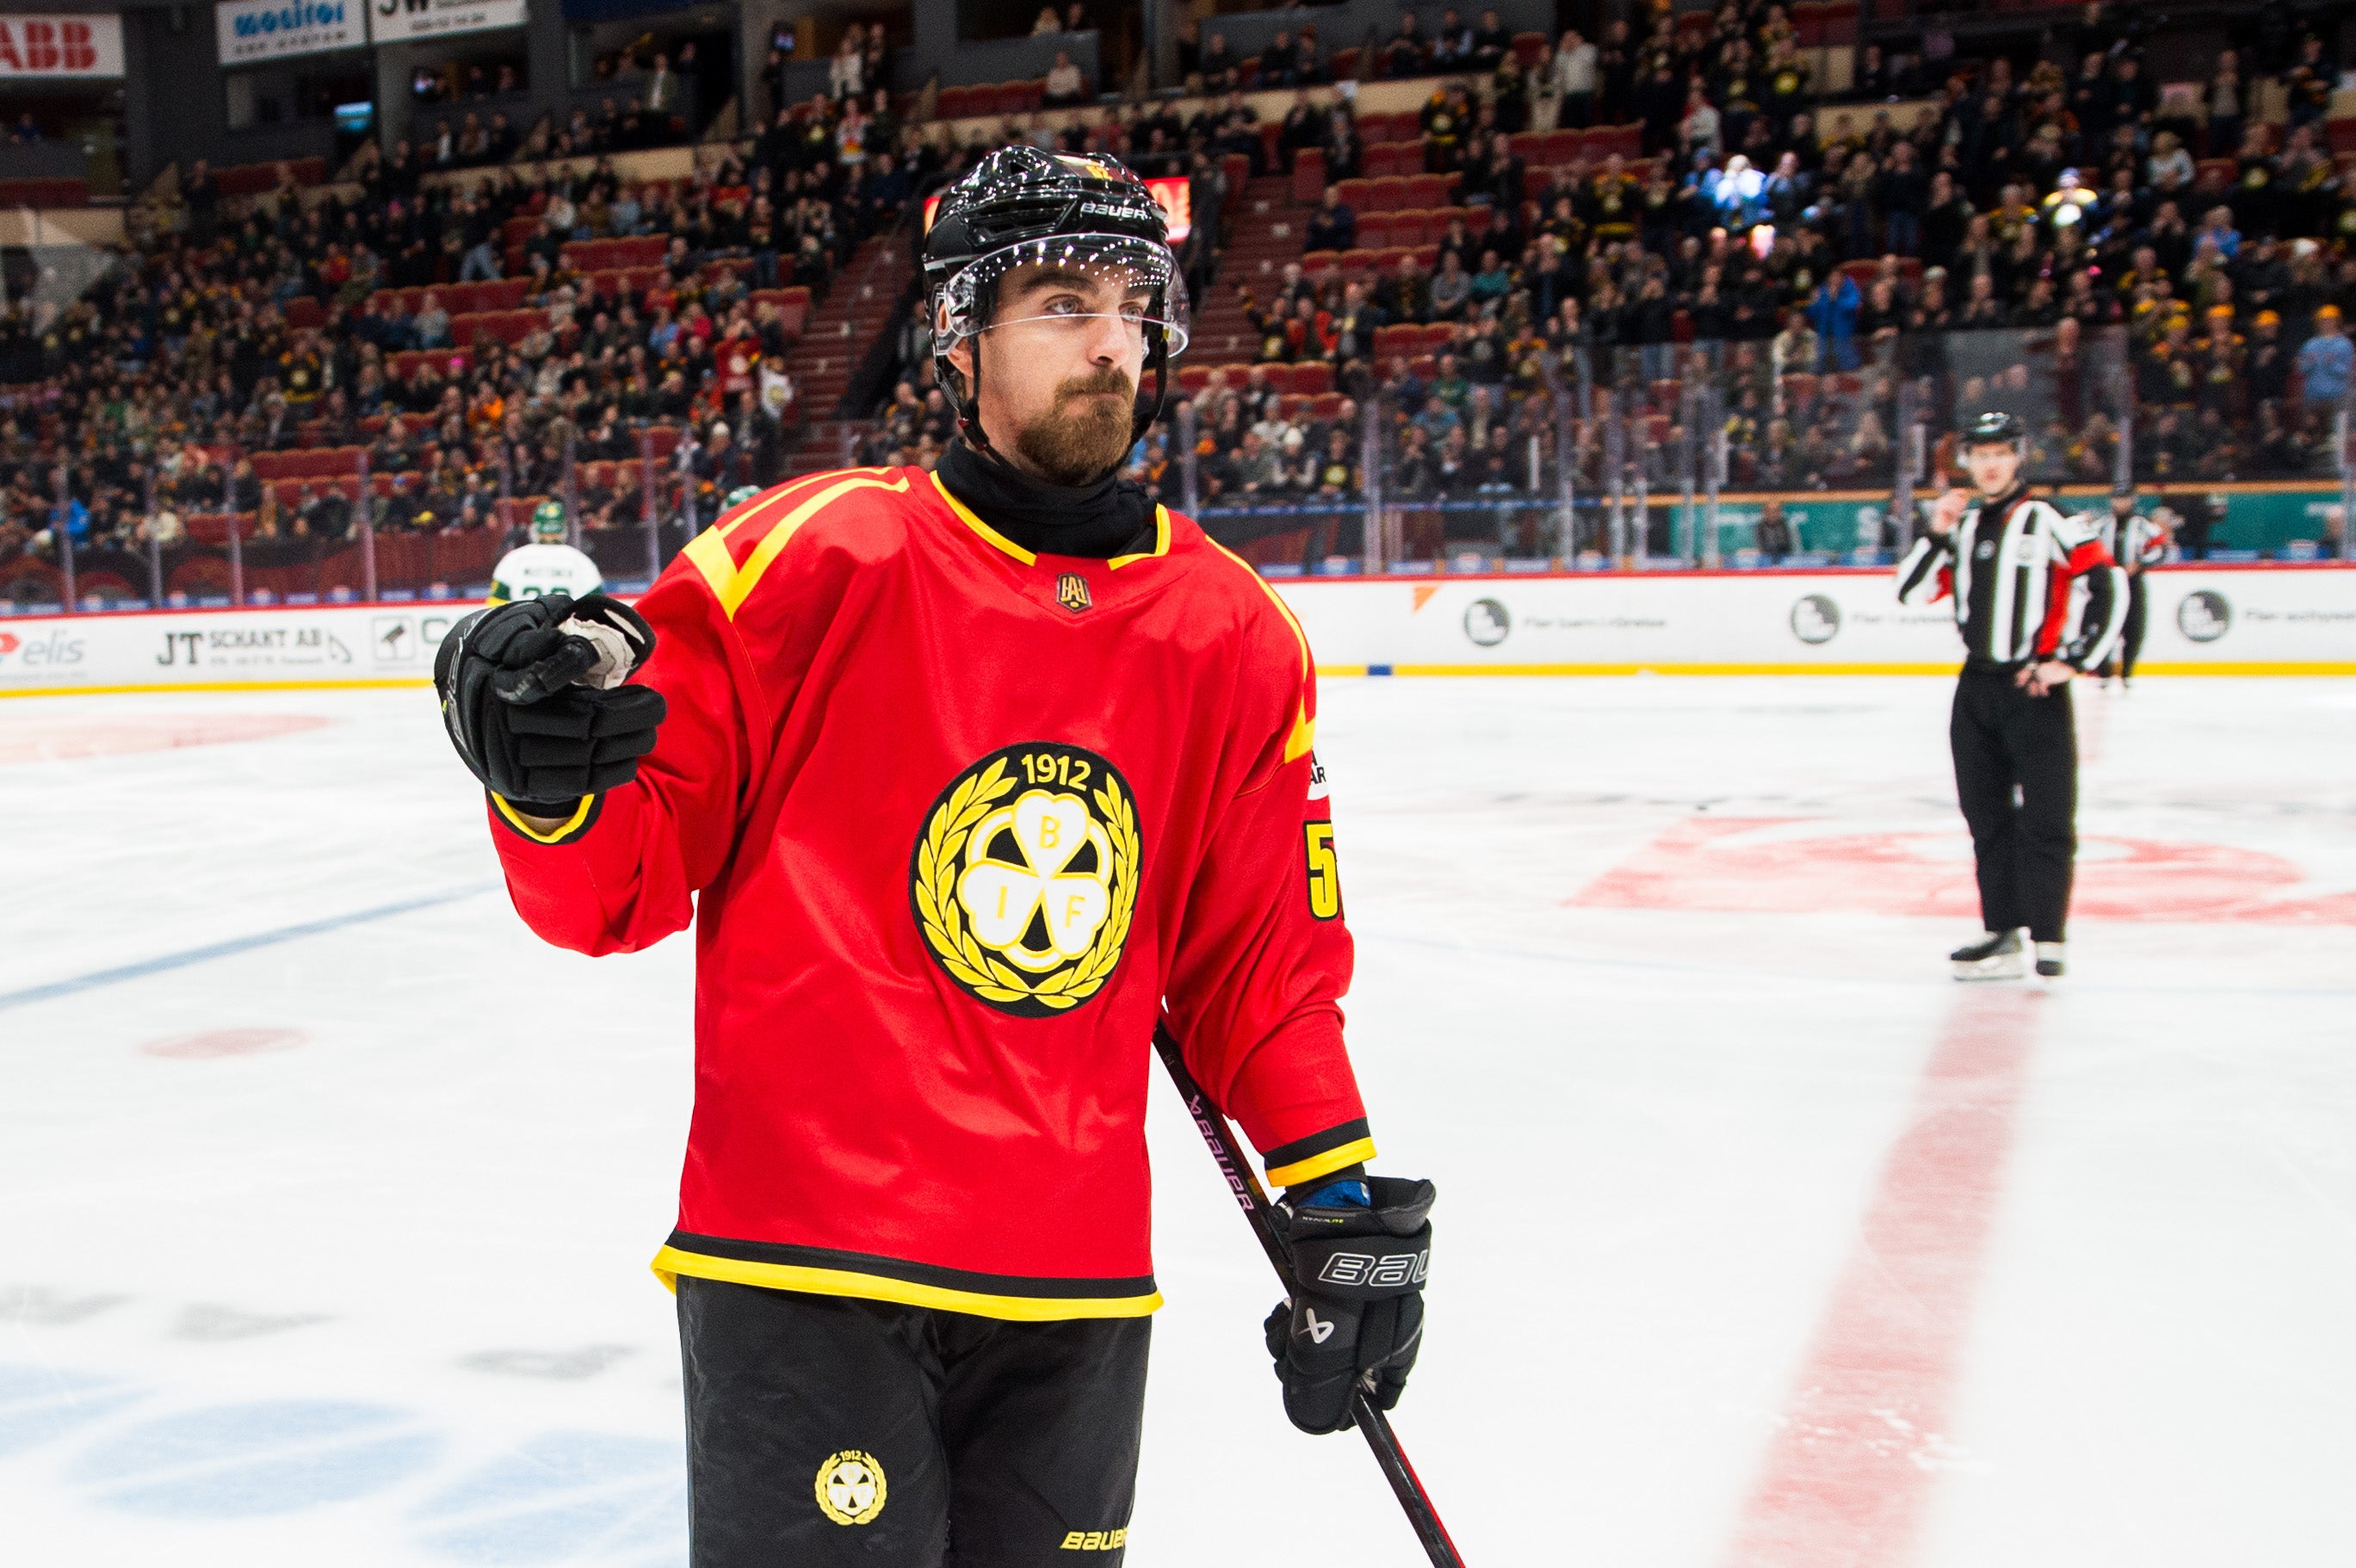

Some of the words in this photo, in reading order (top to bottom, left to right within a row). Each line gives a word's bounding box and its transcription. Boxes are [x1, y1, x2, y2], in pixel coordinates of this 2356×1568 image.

[23, 629, 84, 665] elis
[157, 632, 203, 665] JT
[1021, 753, 1091, 791] 1912
[1039, 815, 1062, 849] B
[839, 1449, 862, 1461] 1912
